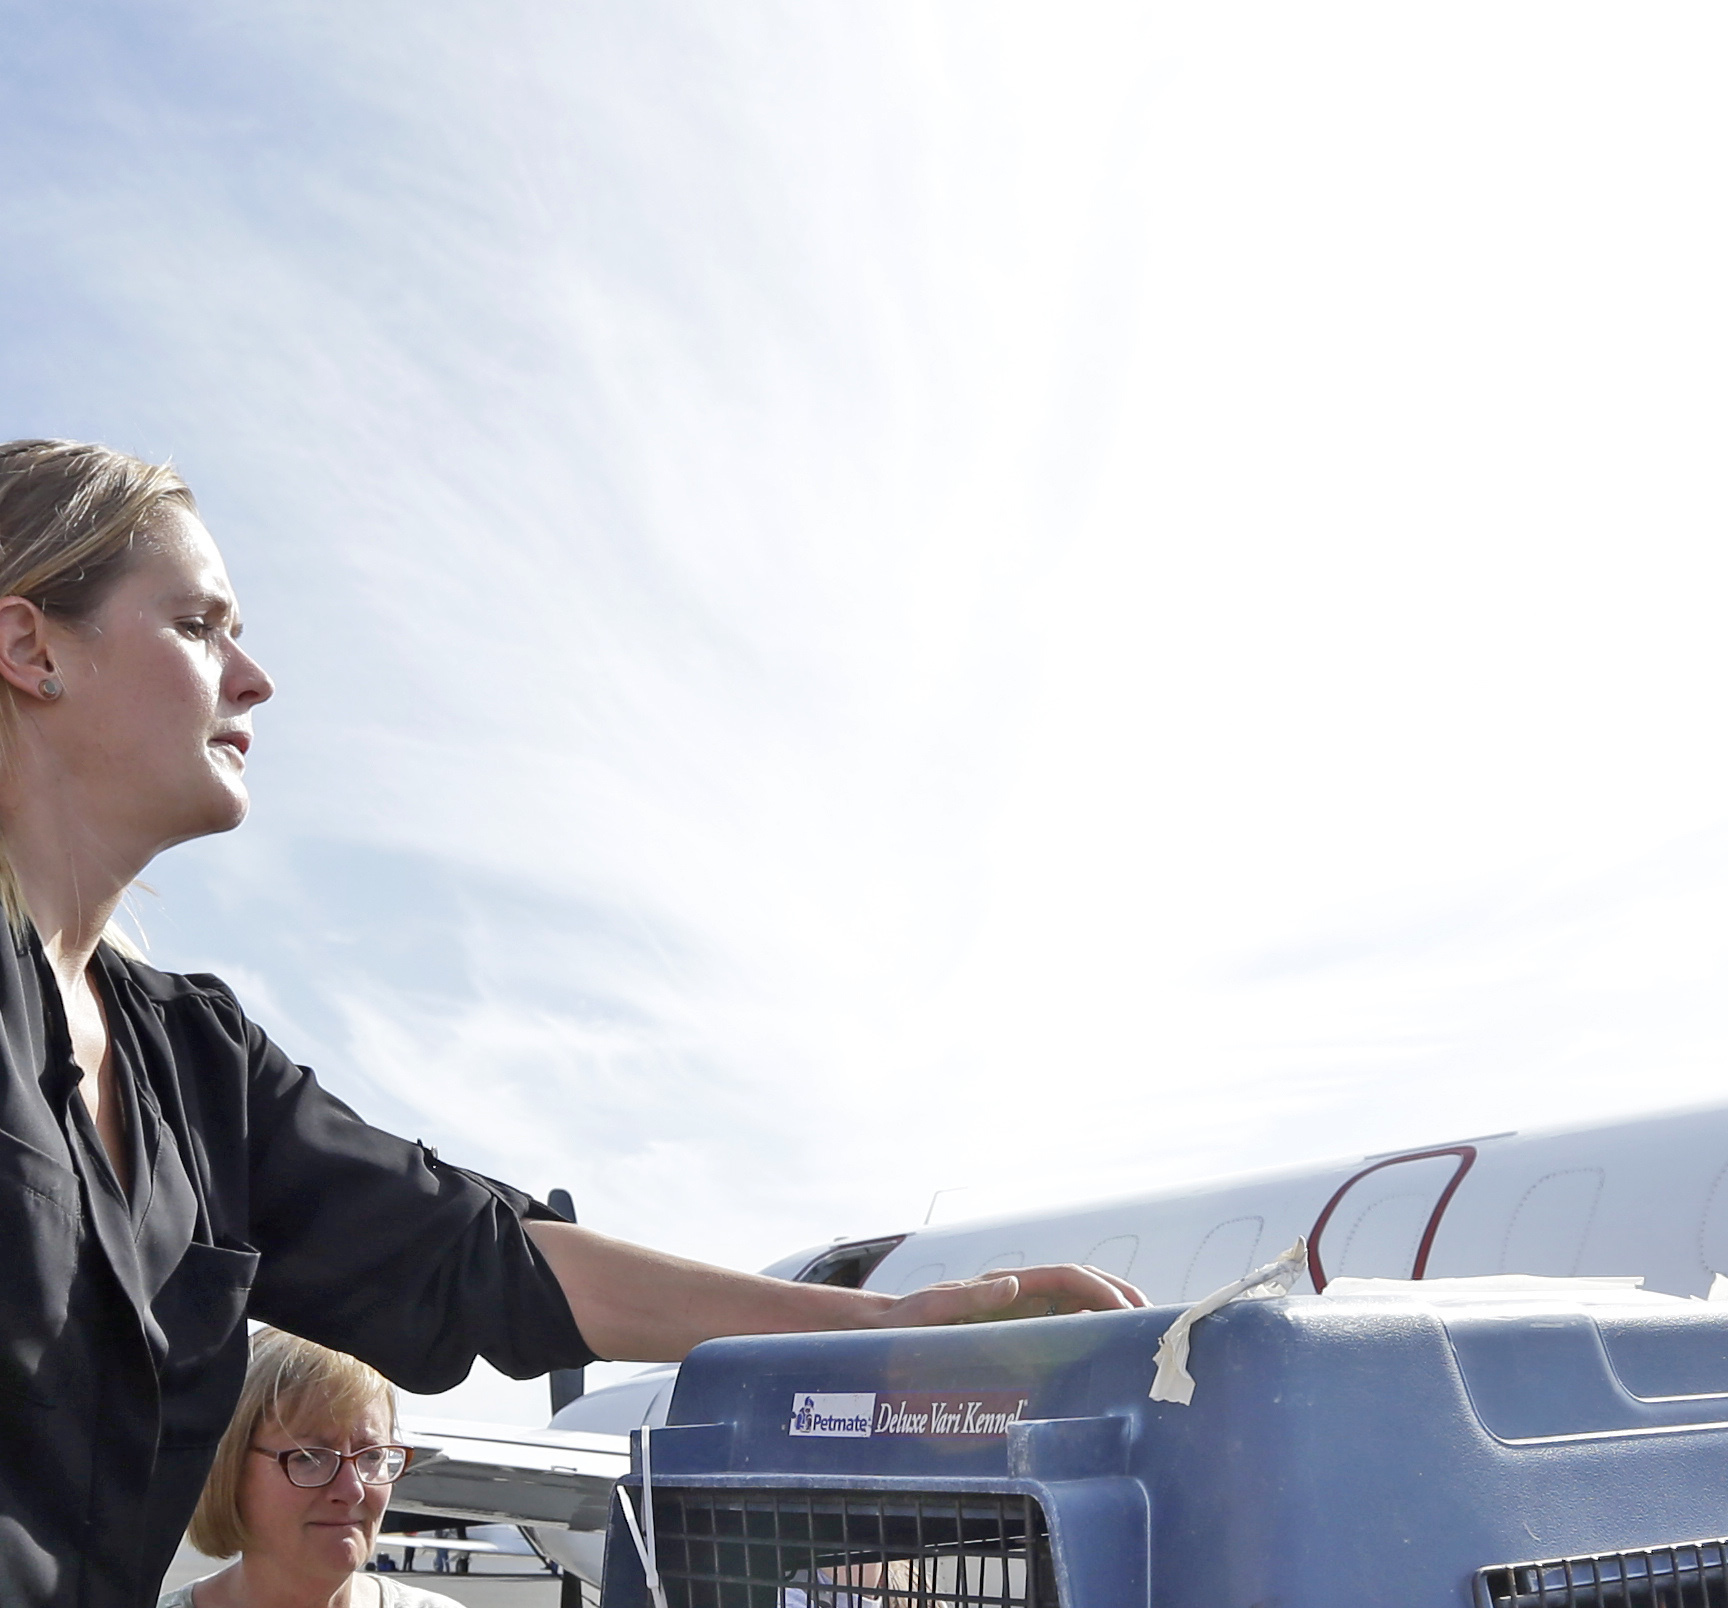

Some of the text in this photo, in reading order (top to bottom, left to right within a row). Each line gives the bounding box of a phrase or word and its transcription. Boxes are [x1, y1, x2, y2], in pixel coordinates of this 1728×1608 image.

[813, 1413, 868, 1432] Petmate
[874, 1401, 928, 1434] Deluxe
[930, 1402, 963, 1434] Vari
